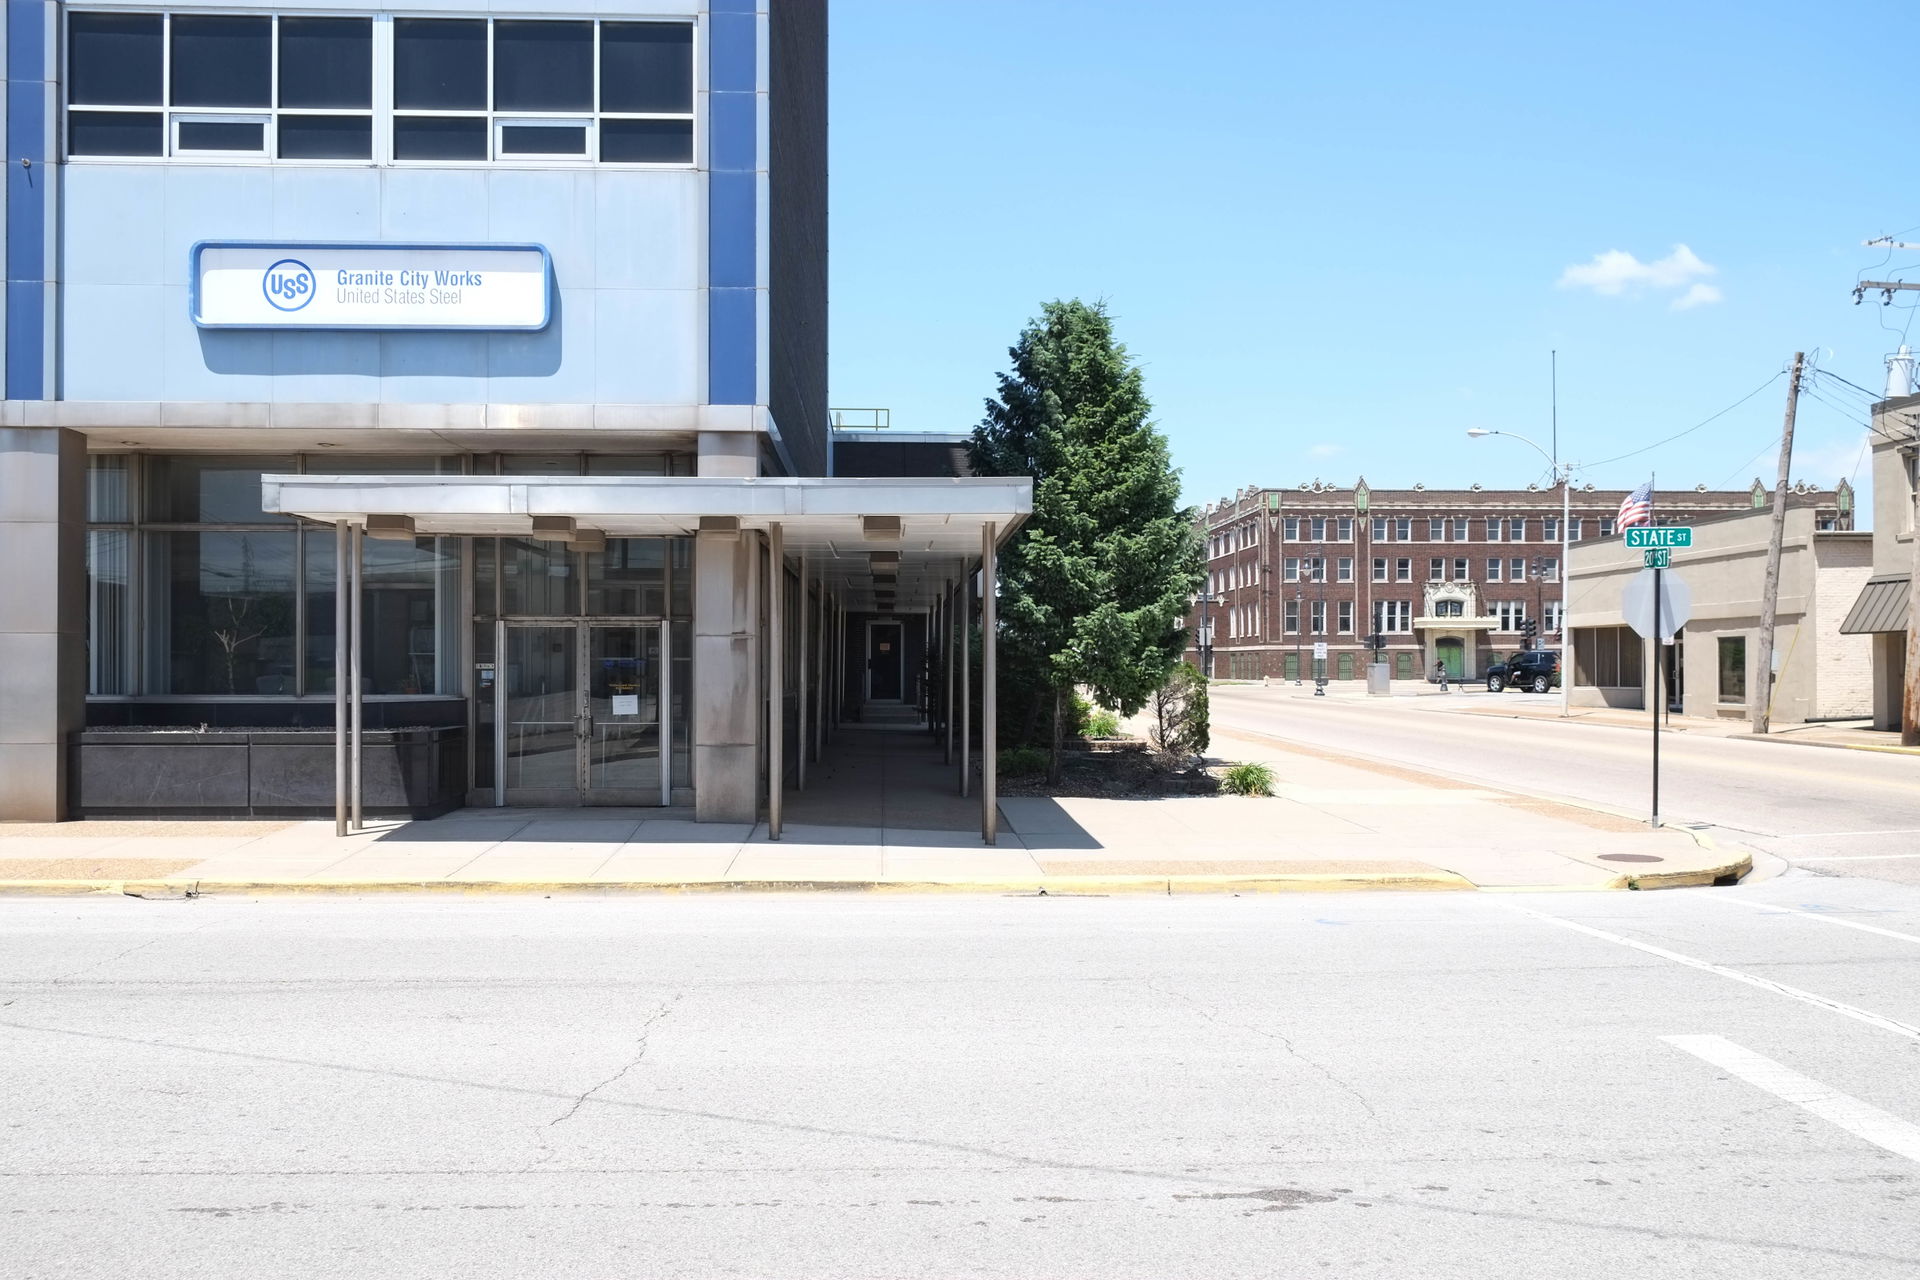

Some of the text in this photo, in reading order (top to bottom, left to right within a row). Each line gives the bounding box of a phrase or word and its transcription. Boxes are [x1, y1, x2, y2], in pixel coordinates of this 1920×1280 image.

[337, 269, 482, 289] Granite City Works
[336, 287, 462, 305] United States Steel
[1631, 530, 1686, 545] STATE ST
[1657, 550, 1667, 565] ST
